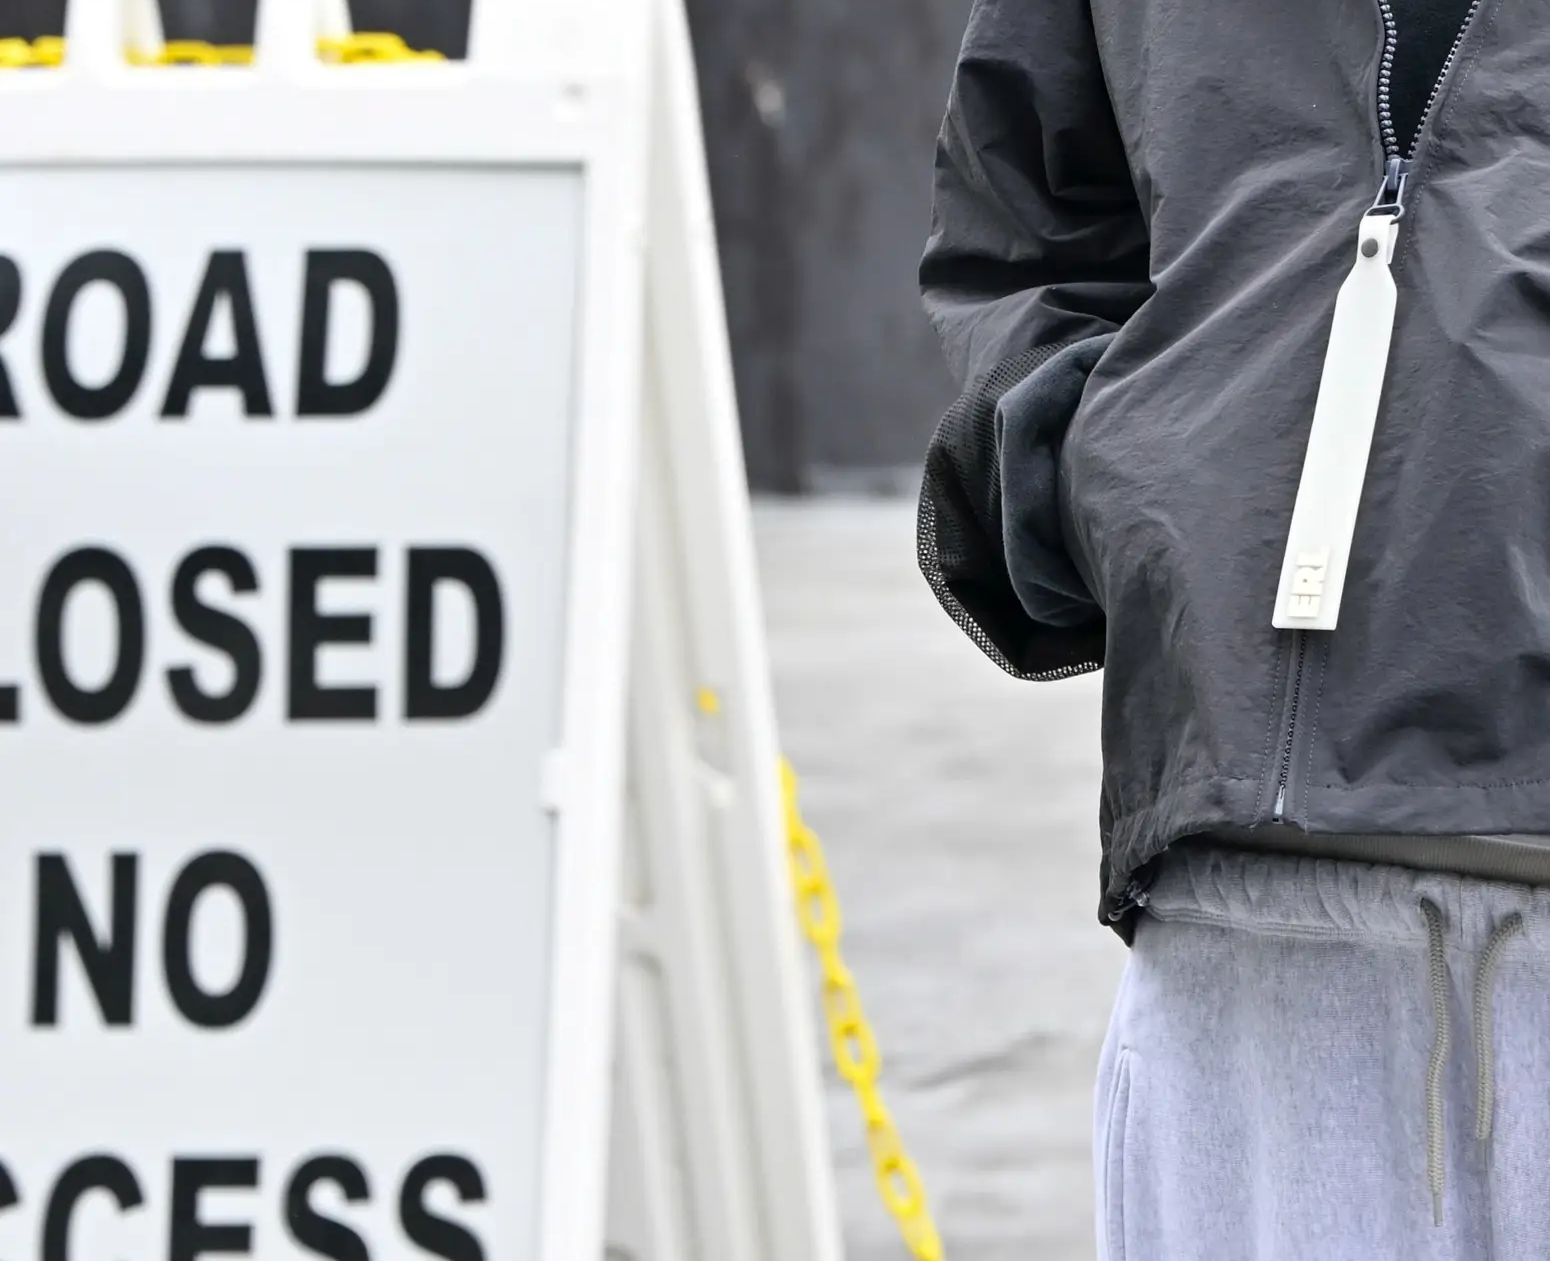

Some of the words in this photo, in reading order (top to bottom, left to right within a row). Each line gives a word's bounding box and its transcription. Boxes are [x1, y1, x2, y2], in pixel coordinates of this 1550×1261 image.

[0, 246, 402, 423] OAD
[0, 542, 508, 728] OSED
[29, 847, 276, 1032] NO
[0, 1151, 490, 1261] CESS
